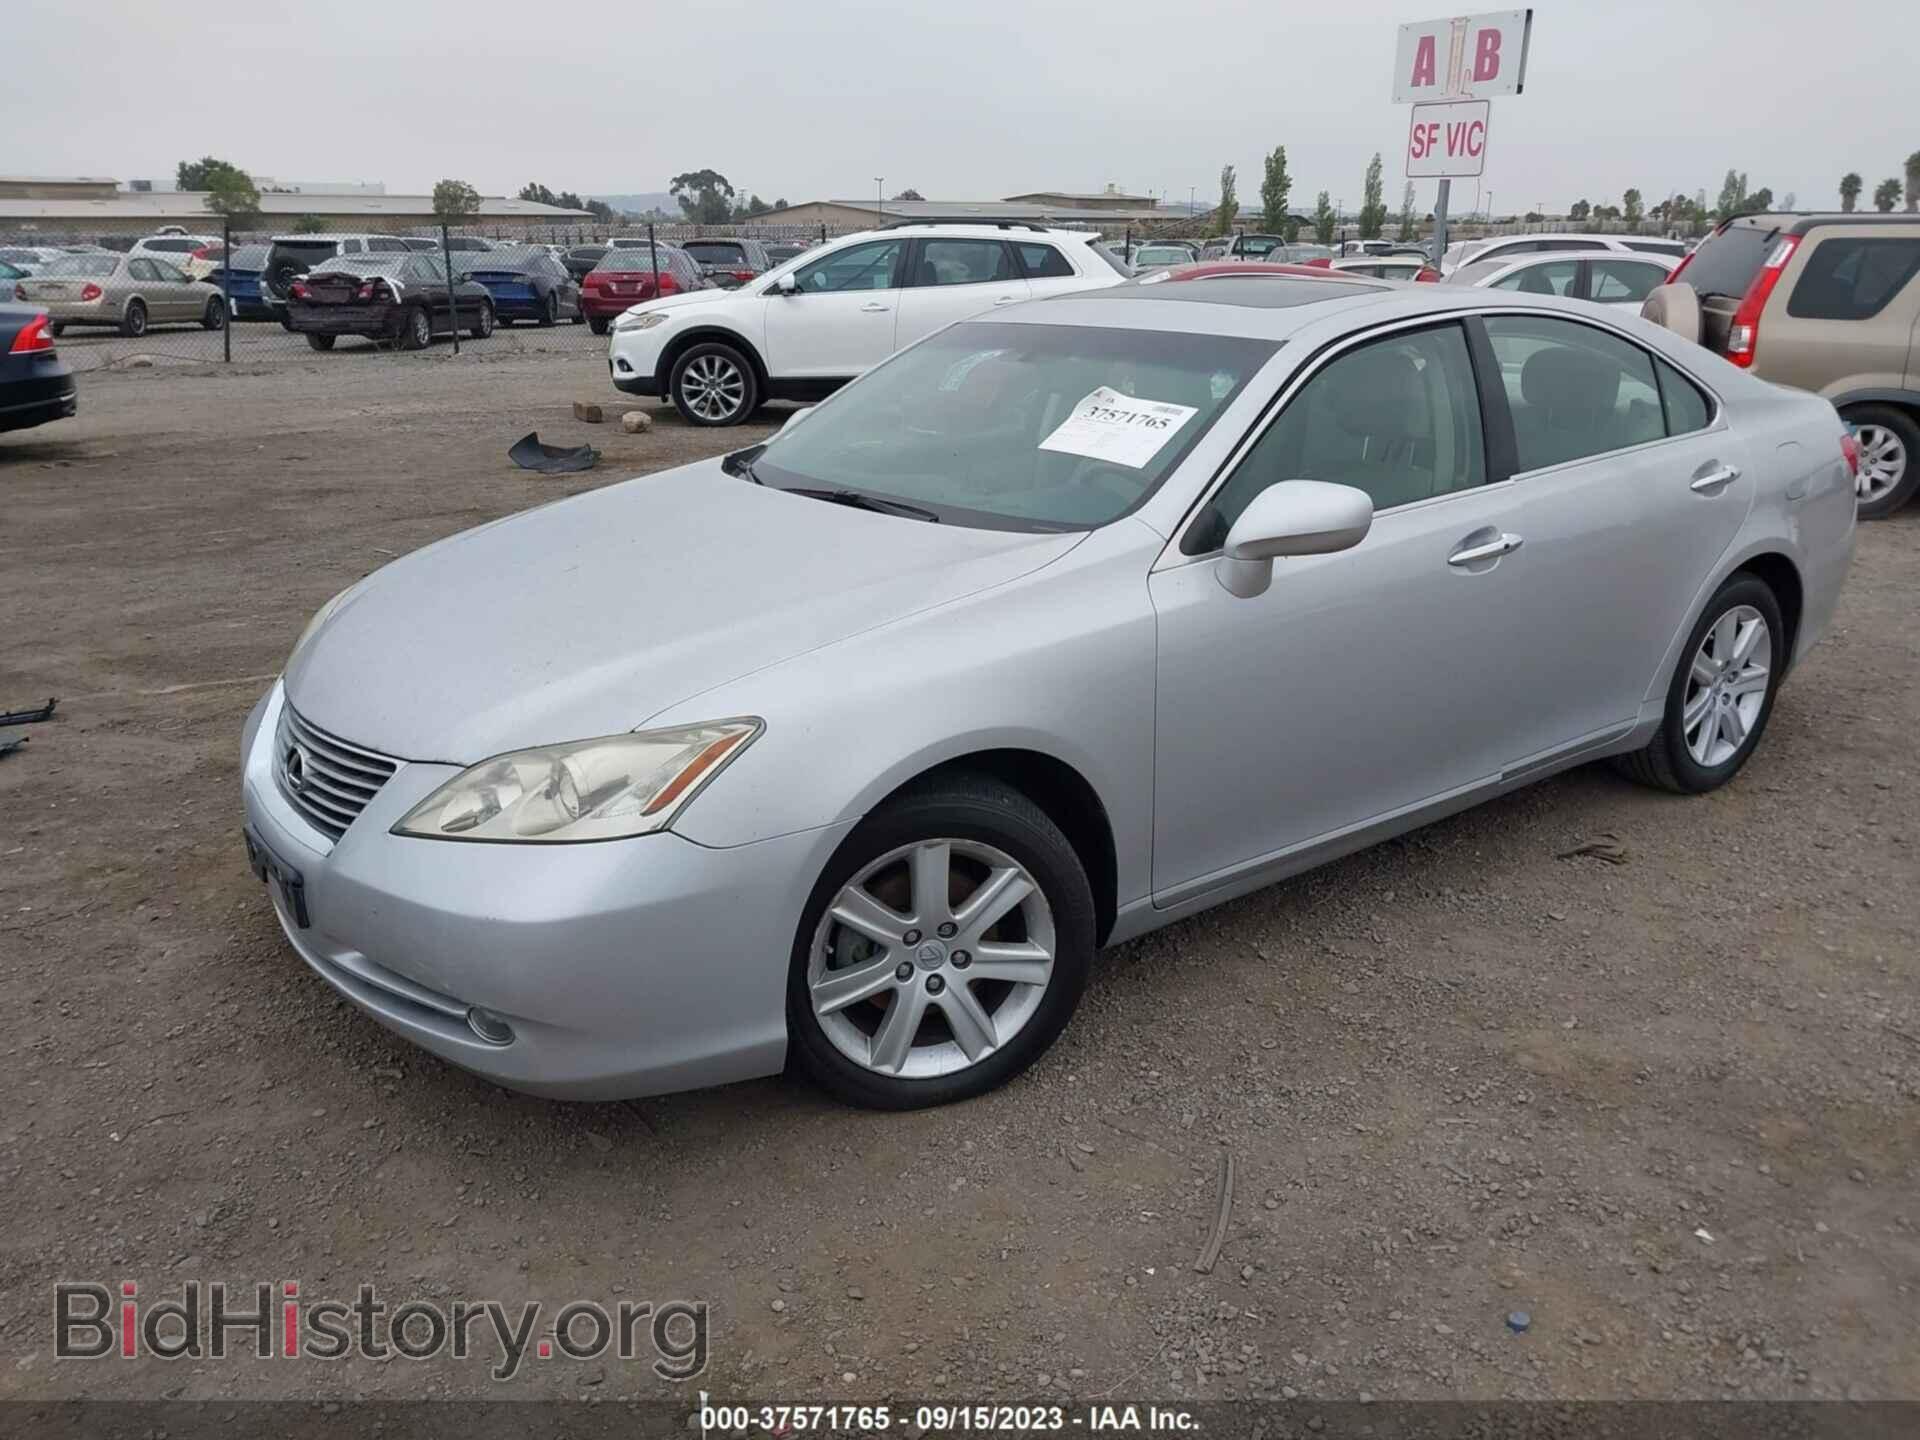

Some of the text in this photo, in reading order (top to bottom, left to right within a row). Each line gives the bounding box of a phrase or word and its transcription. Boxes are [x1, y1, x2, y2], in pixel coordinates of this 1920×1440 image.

[1410, 28, 1502, 88] A B
[1411, 120, 1484, 159] SF VIC
[1083, 406, 1172, 430] 37571765
